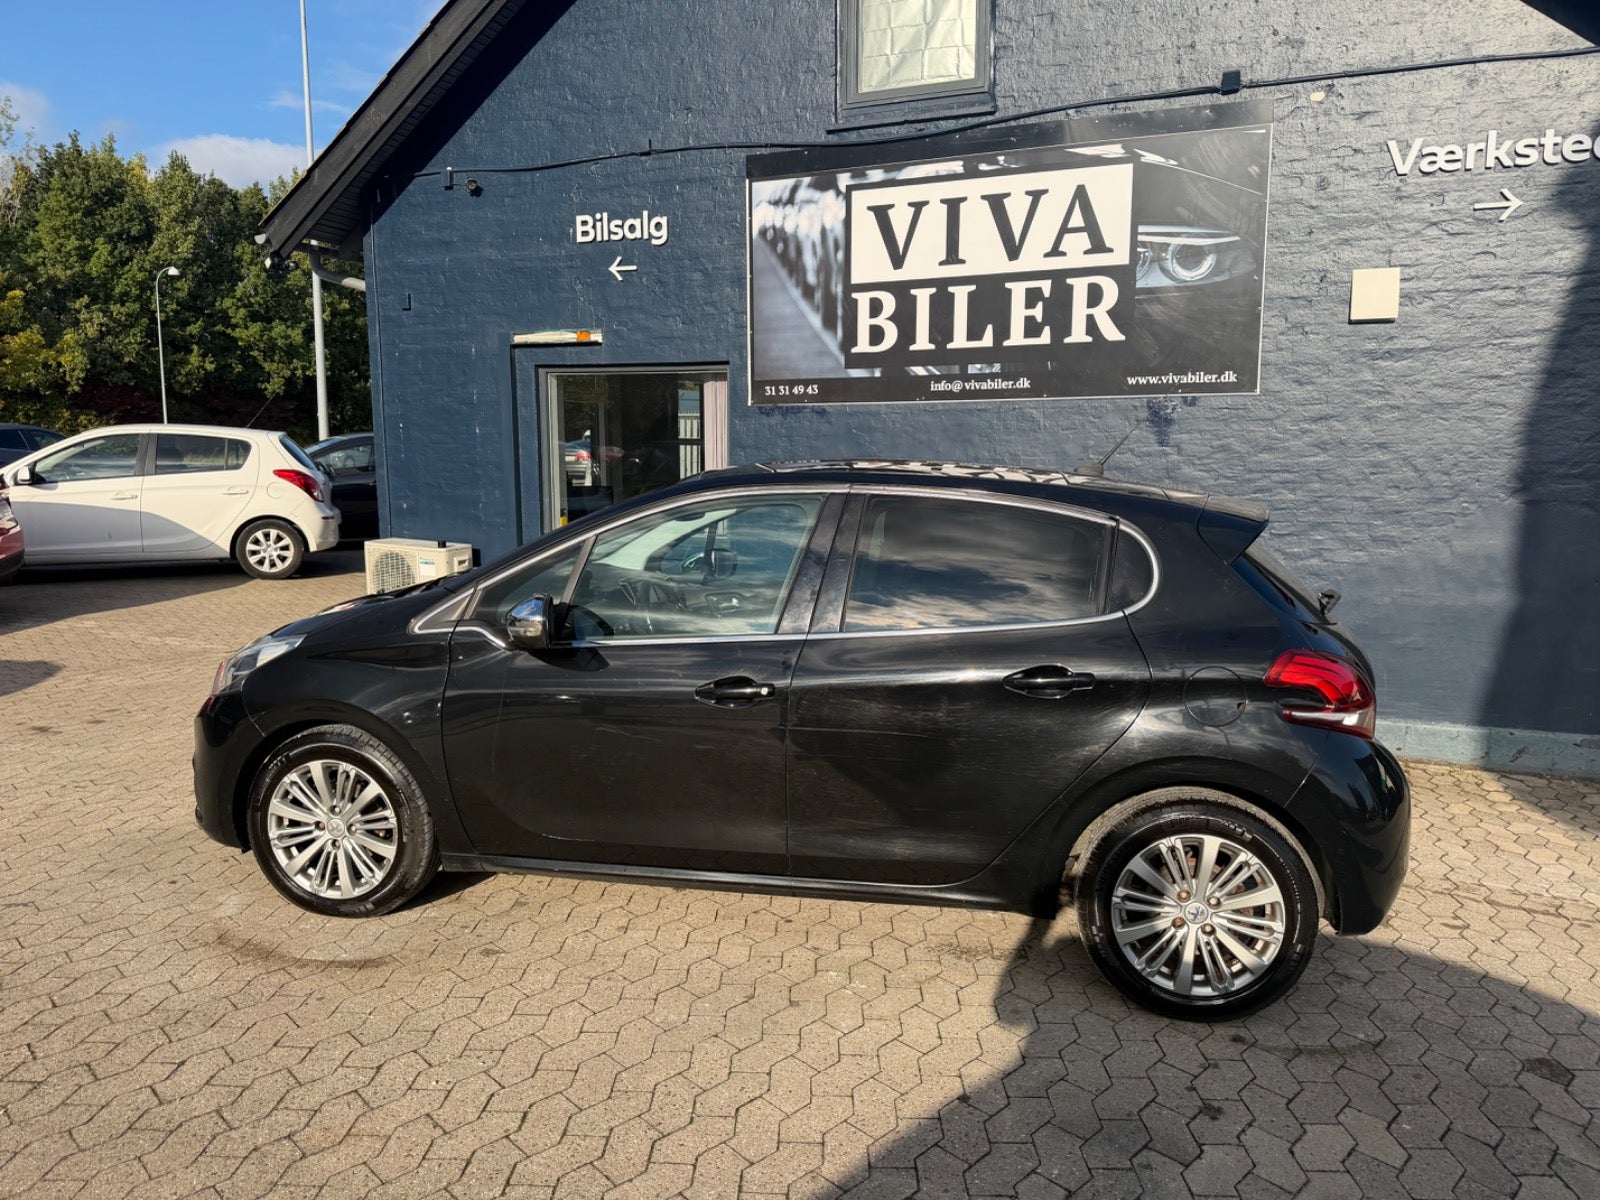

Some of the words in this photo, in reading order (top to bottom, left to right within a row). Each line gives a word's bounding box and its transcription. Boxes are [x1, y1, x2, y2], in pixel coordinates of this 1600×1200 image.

[576, 210, 667, 245] Bilsalg
[867, 184, 1114, 270] VIVA
[850, 275, 1126, 354] BILER
[764, 386, 776, 396] 31
[778, 385, 790, 395] 31
[792, 384, 804, 394] 49
[806, 384, 819, 394] 43
[930, 377, 1031, 392] info@vivabiler.dk
[1126, 370, 1238, 385] www.vivabiler.dk
